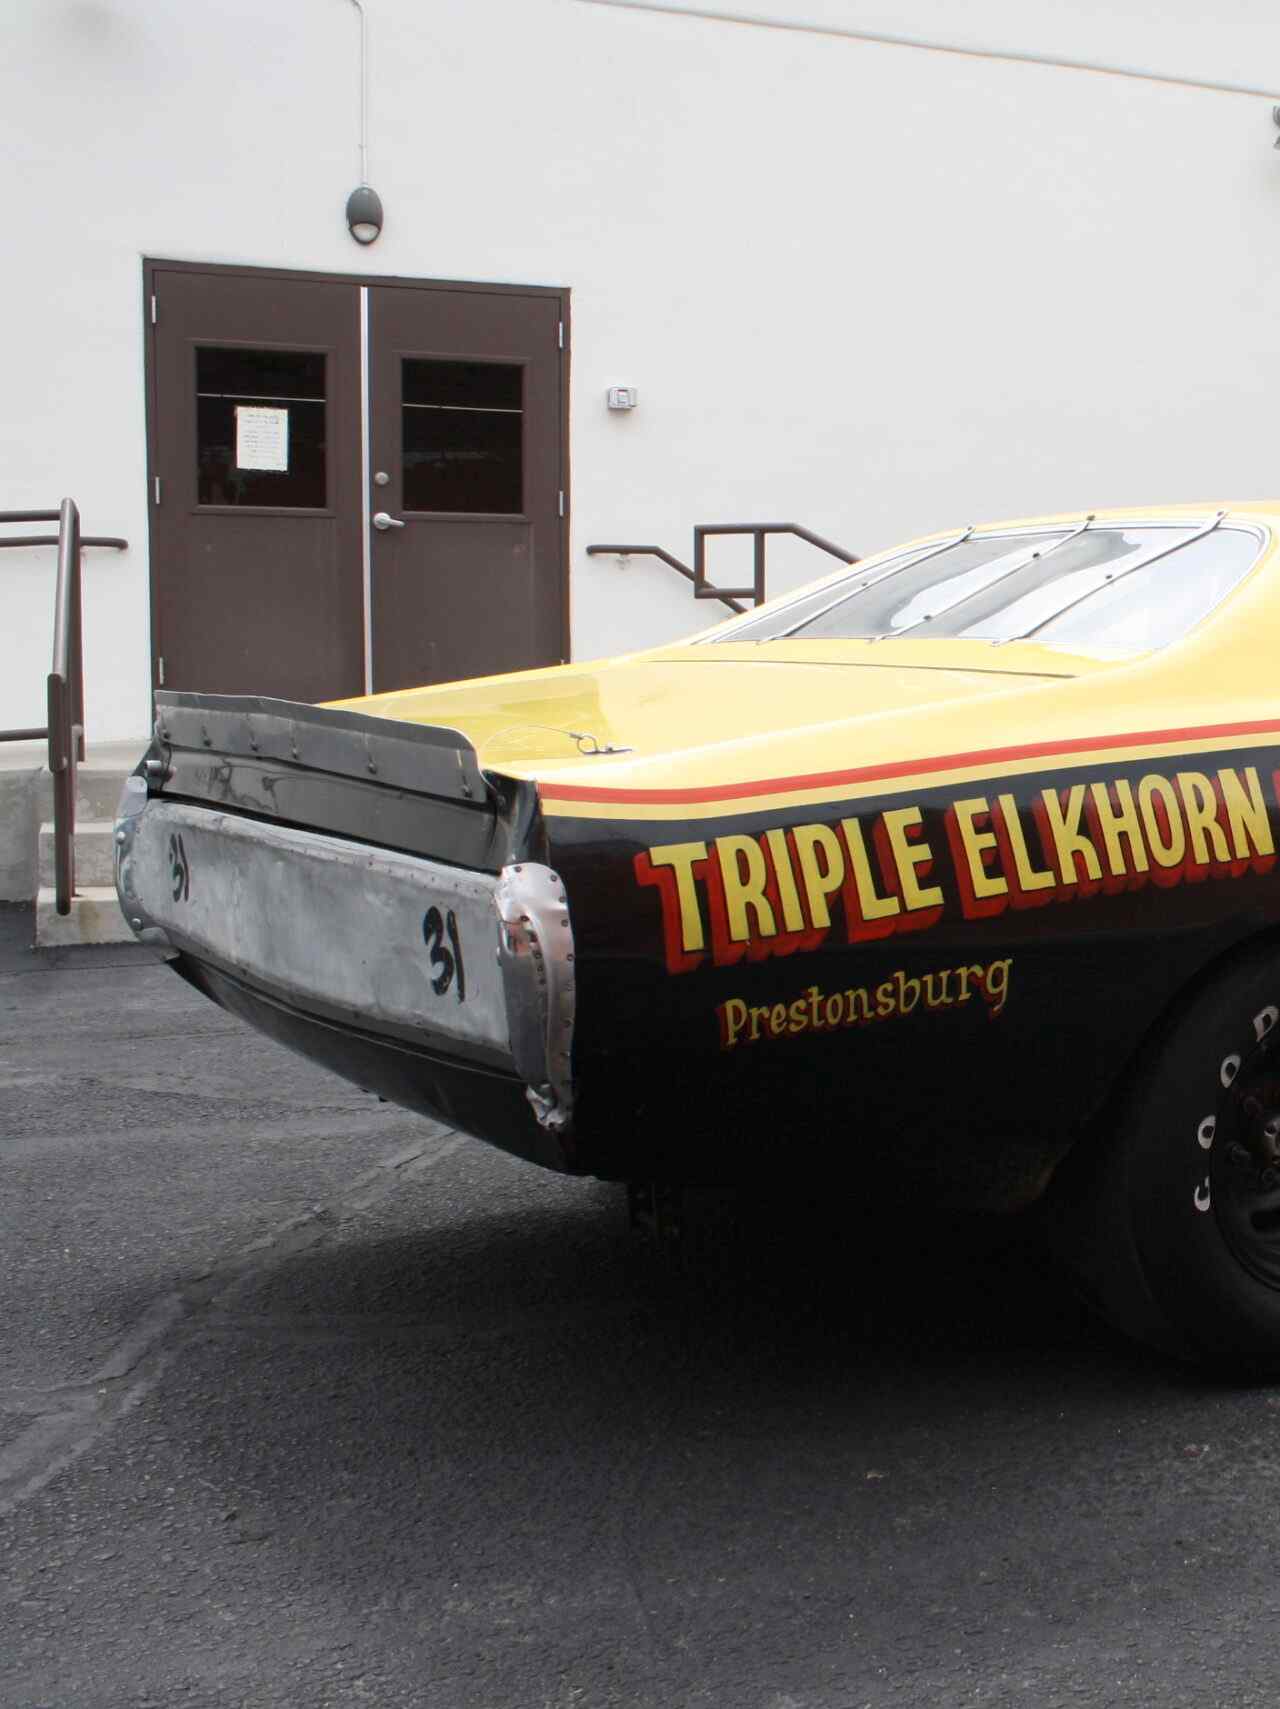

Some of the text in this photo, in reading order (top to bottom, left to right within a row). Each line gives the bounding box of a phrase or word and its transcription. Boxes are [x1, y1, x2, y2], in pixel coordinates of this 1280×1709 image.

[646, 805, 945, 955] TRIPLE
[952, 765, 1276, 899] ELKHORN
[422, 904, 467, 1005] 31
[723, 955, 1014, 1048] Prestonsburg
